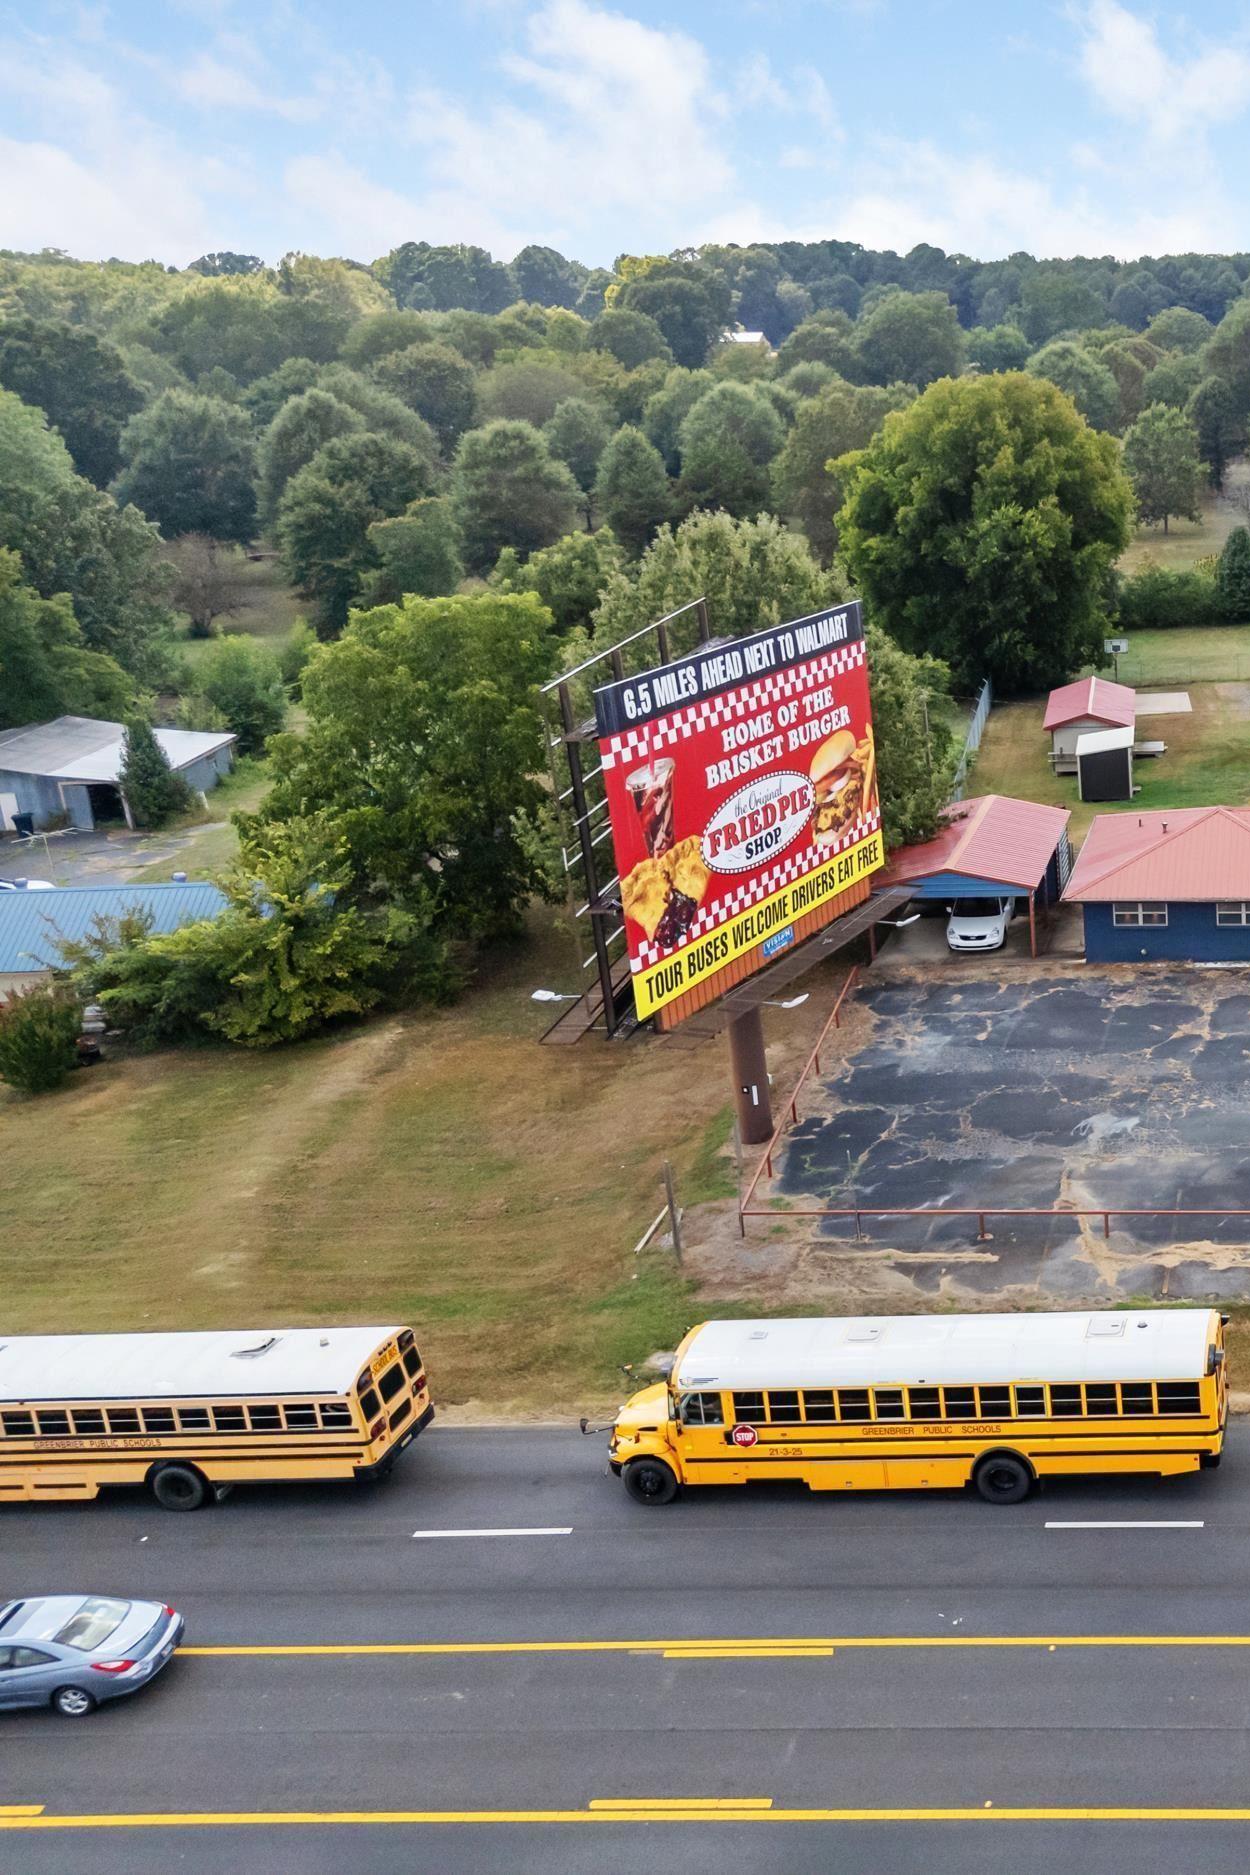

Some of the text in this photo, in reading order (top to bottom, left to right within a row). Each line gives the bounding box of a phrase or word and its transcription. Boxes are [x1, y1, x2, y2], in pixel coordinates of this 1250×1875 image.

[623, 613, 848, 720] 6.5 MILES AHEAD NEXT TO WALMART
[721, 685, 834, 752] HOME OF THE
[705, 705, 851, 789] BRISKET BURGER
[708, 784, 811, 858] FRIED PIE
[734, 778, 783, 818] the Original
[745, 827, 782, 859] SHOP
[646, 839, 879, 1003] TOUR BUSES WELCOME DRIVERS EAT FREE
[89, 1440, 118, 1449] PUBLIC
[123, 1438, 162, 1447] SCHOOLS
[735, 1432, 754, 1441] STOP
[861, 1425, 1002, 1436] GREENBRIER PUBLIC SCHOOLS
